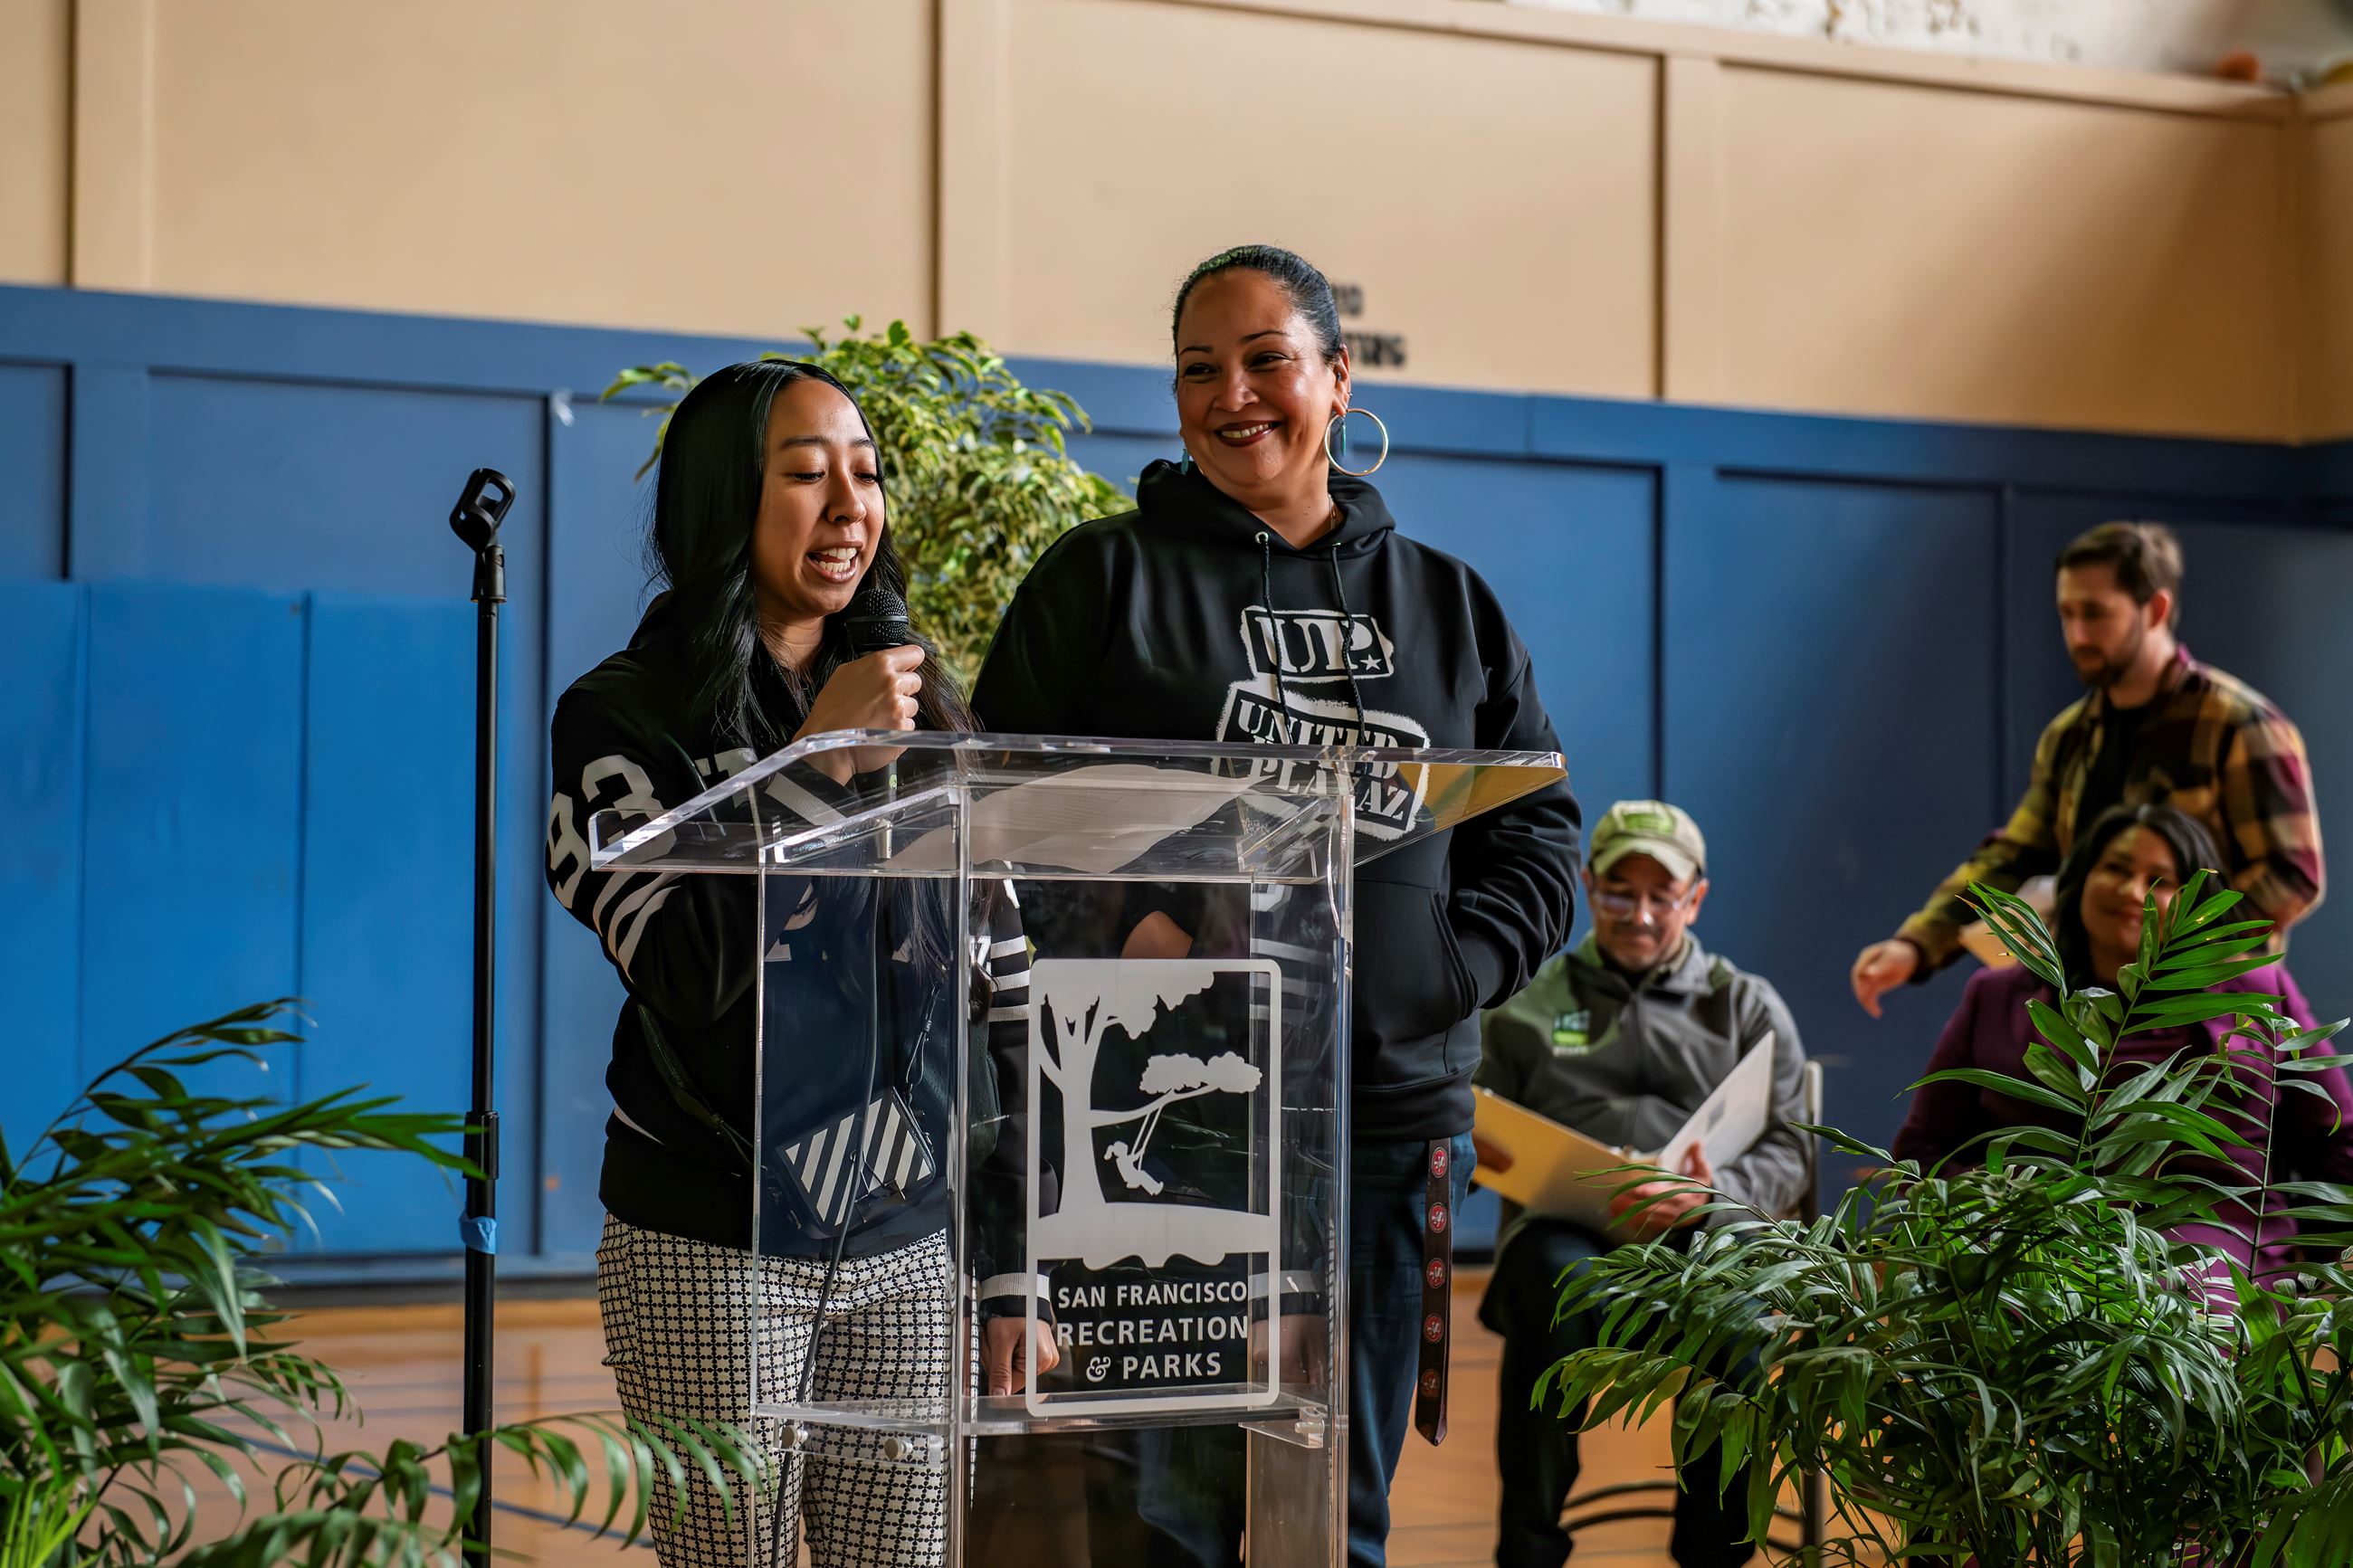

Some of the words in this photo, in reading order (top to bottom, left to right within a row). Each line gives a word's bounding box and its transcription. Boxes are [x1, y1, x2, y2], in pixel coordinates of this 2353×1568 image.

[1254, 615, 1373, 673] UP
[1057, 1286, 1106, 1309] SAN
[1117, 1280, 1248, 1307] FRANCISCO
[1057, 1315, 1249, 1347] RECREATION
[1086, 1356, 1111, 1383] &
[1123, 1352, 1222, 1380] PARKS
